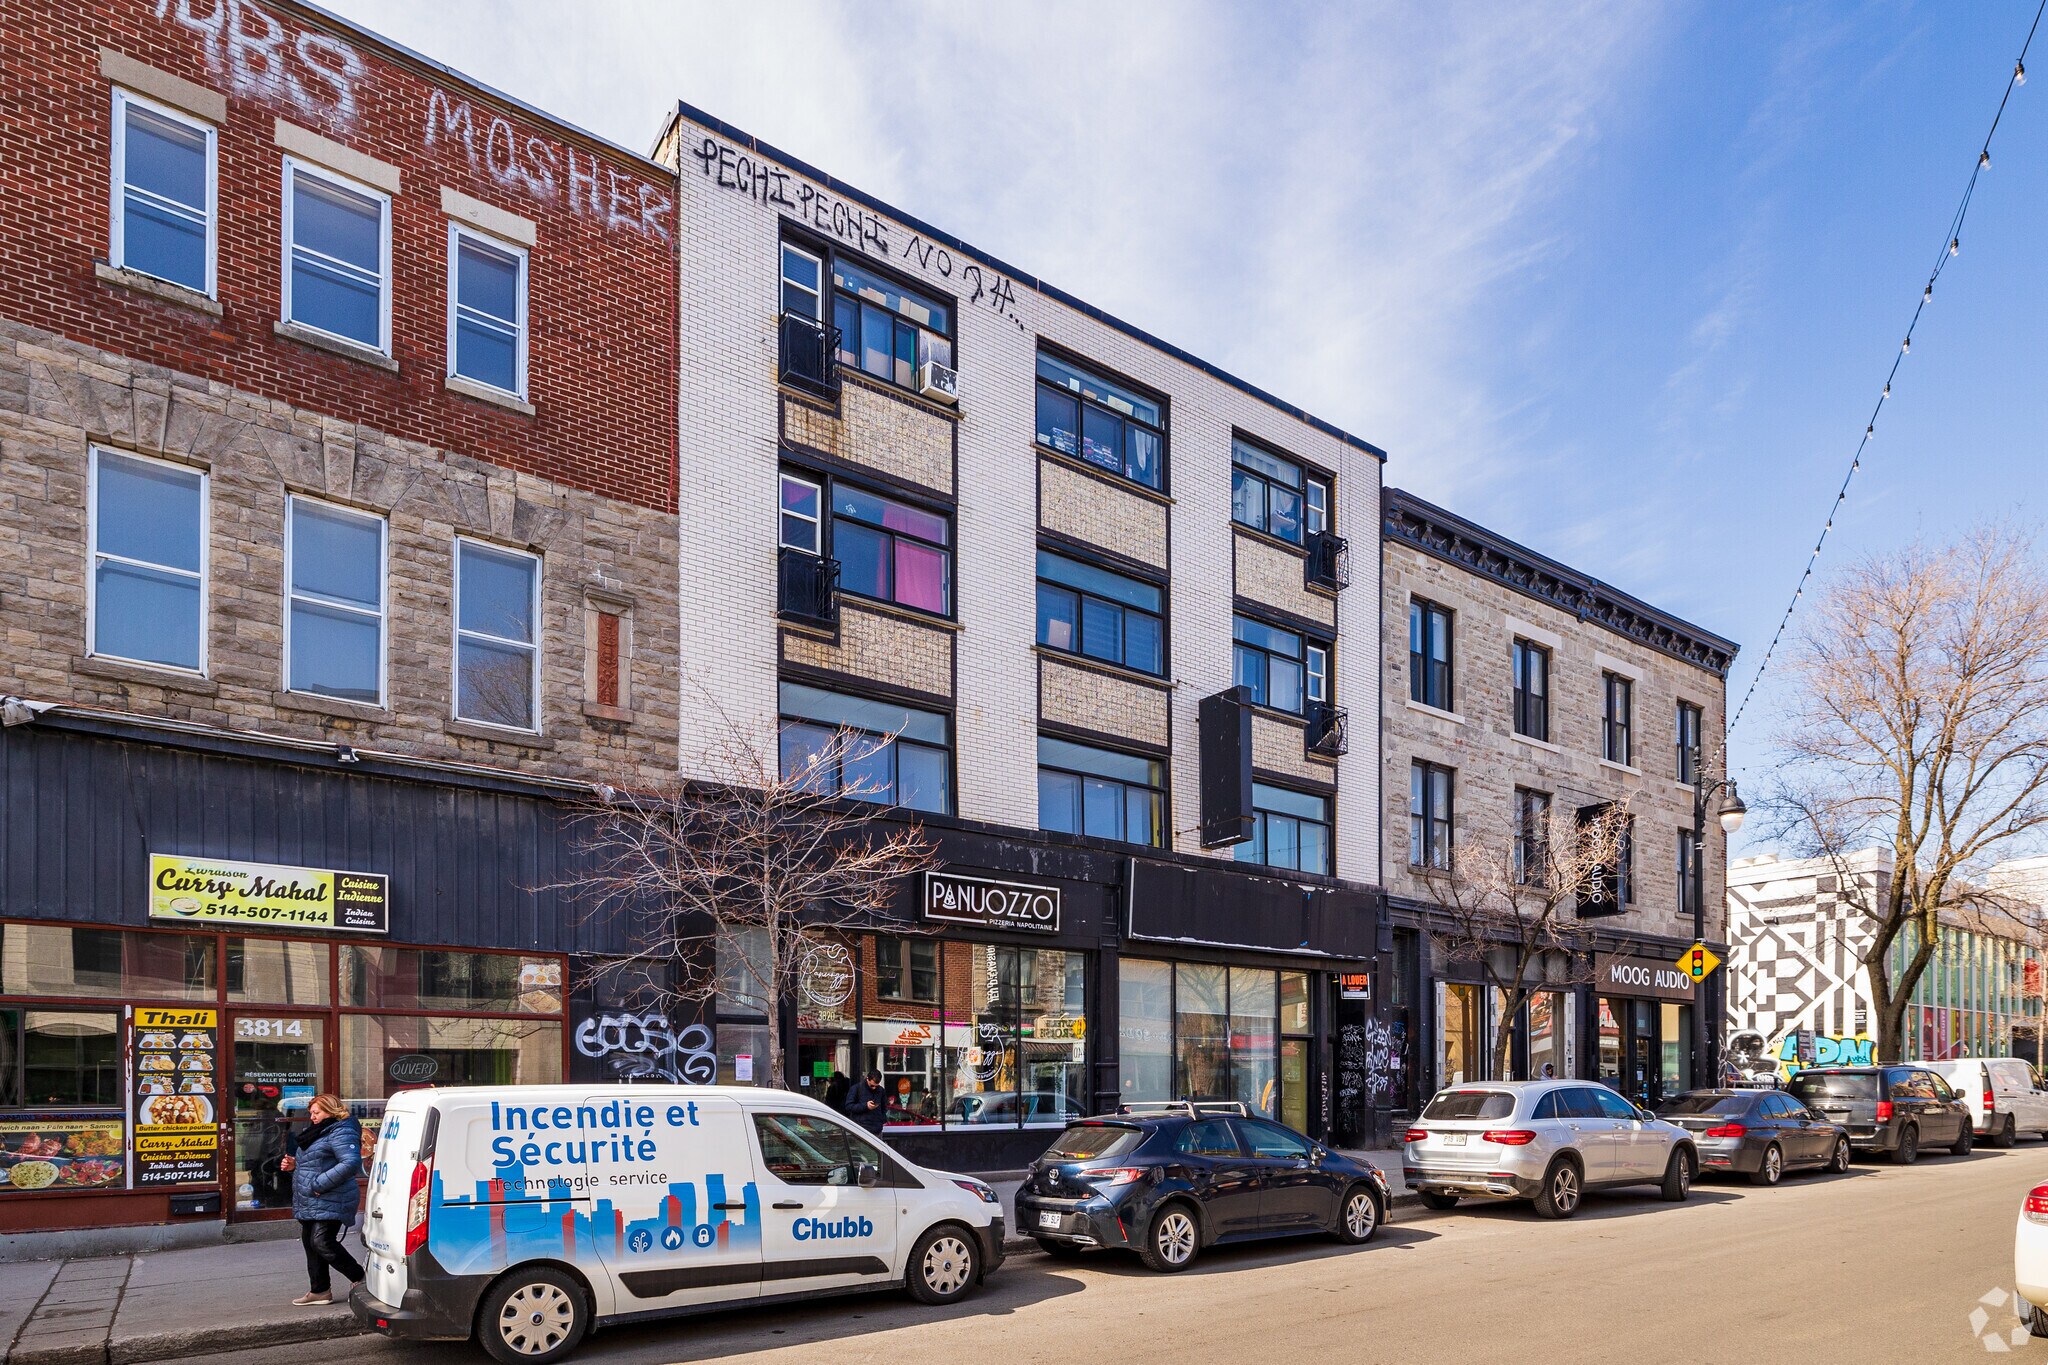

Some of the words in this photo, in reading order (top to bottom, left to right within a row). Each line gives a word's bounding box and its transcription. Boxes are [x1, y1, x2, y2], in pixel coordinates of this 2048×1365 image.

[156, 868, 235, 898] Curry
[239, 875, 328, 901] Mahal
[341, 877, 379, 890] Cuisine
[336, 890, 384, 903] Indienne
[205, 903, 328, 923] 514-507-1144
[344, 908, 374, 917] Indian
[345, 916, 376, 926] Cuisine
[989, 918, 1015, 927] PIZZERIA
[1016, 922, 1053, 931] NAPOLITAINE
[1342, 974, 1347, 985] A
[1347, 975, 1367, 985] LOUER
[1611, 964, 1650, 986] MOOG
[1655, 969, 1690, 990] AUDIO
[144, 1011, 208, 1025] Thali
[238, 1020, 302, 1037] 3814
[392, 1062, 434, 1075] OUVERT
[491, 1100, 655, 1131] Incendie
[666, 1101, 699, 1126] et
[140, 1139, 173, 1150] Curry
[175, 1137, 214, 1148] Mahal
[491, 1129, 657, 1167] Sécurité
[141, 1153, 173, 1161] Cuisine
[173, 1152, 211, 1160] Indienne
[148, 1162, 175, 1170] Indian
[142, 1170, 210, 1181] 514-507-1144
[491, 1173, 600, 1192] Technologie
[609, 1170, 668, 1185] service
[792, 1215, 873, 1241] Chubb
